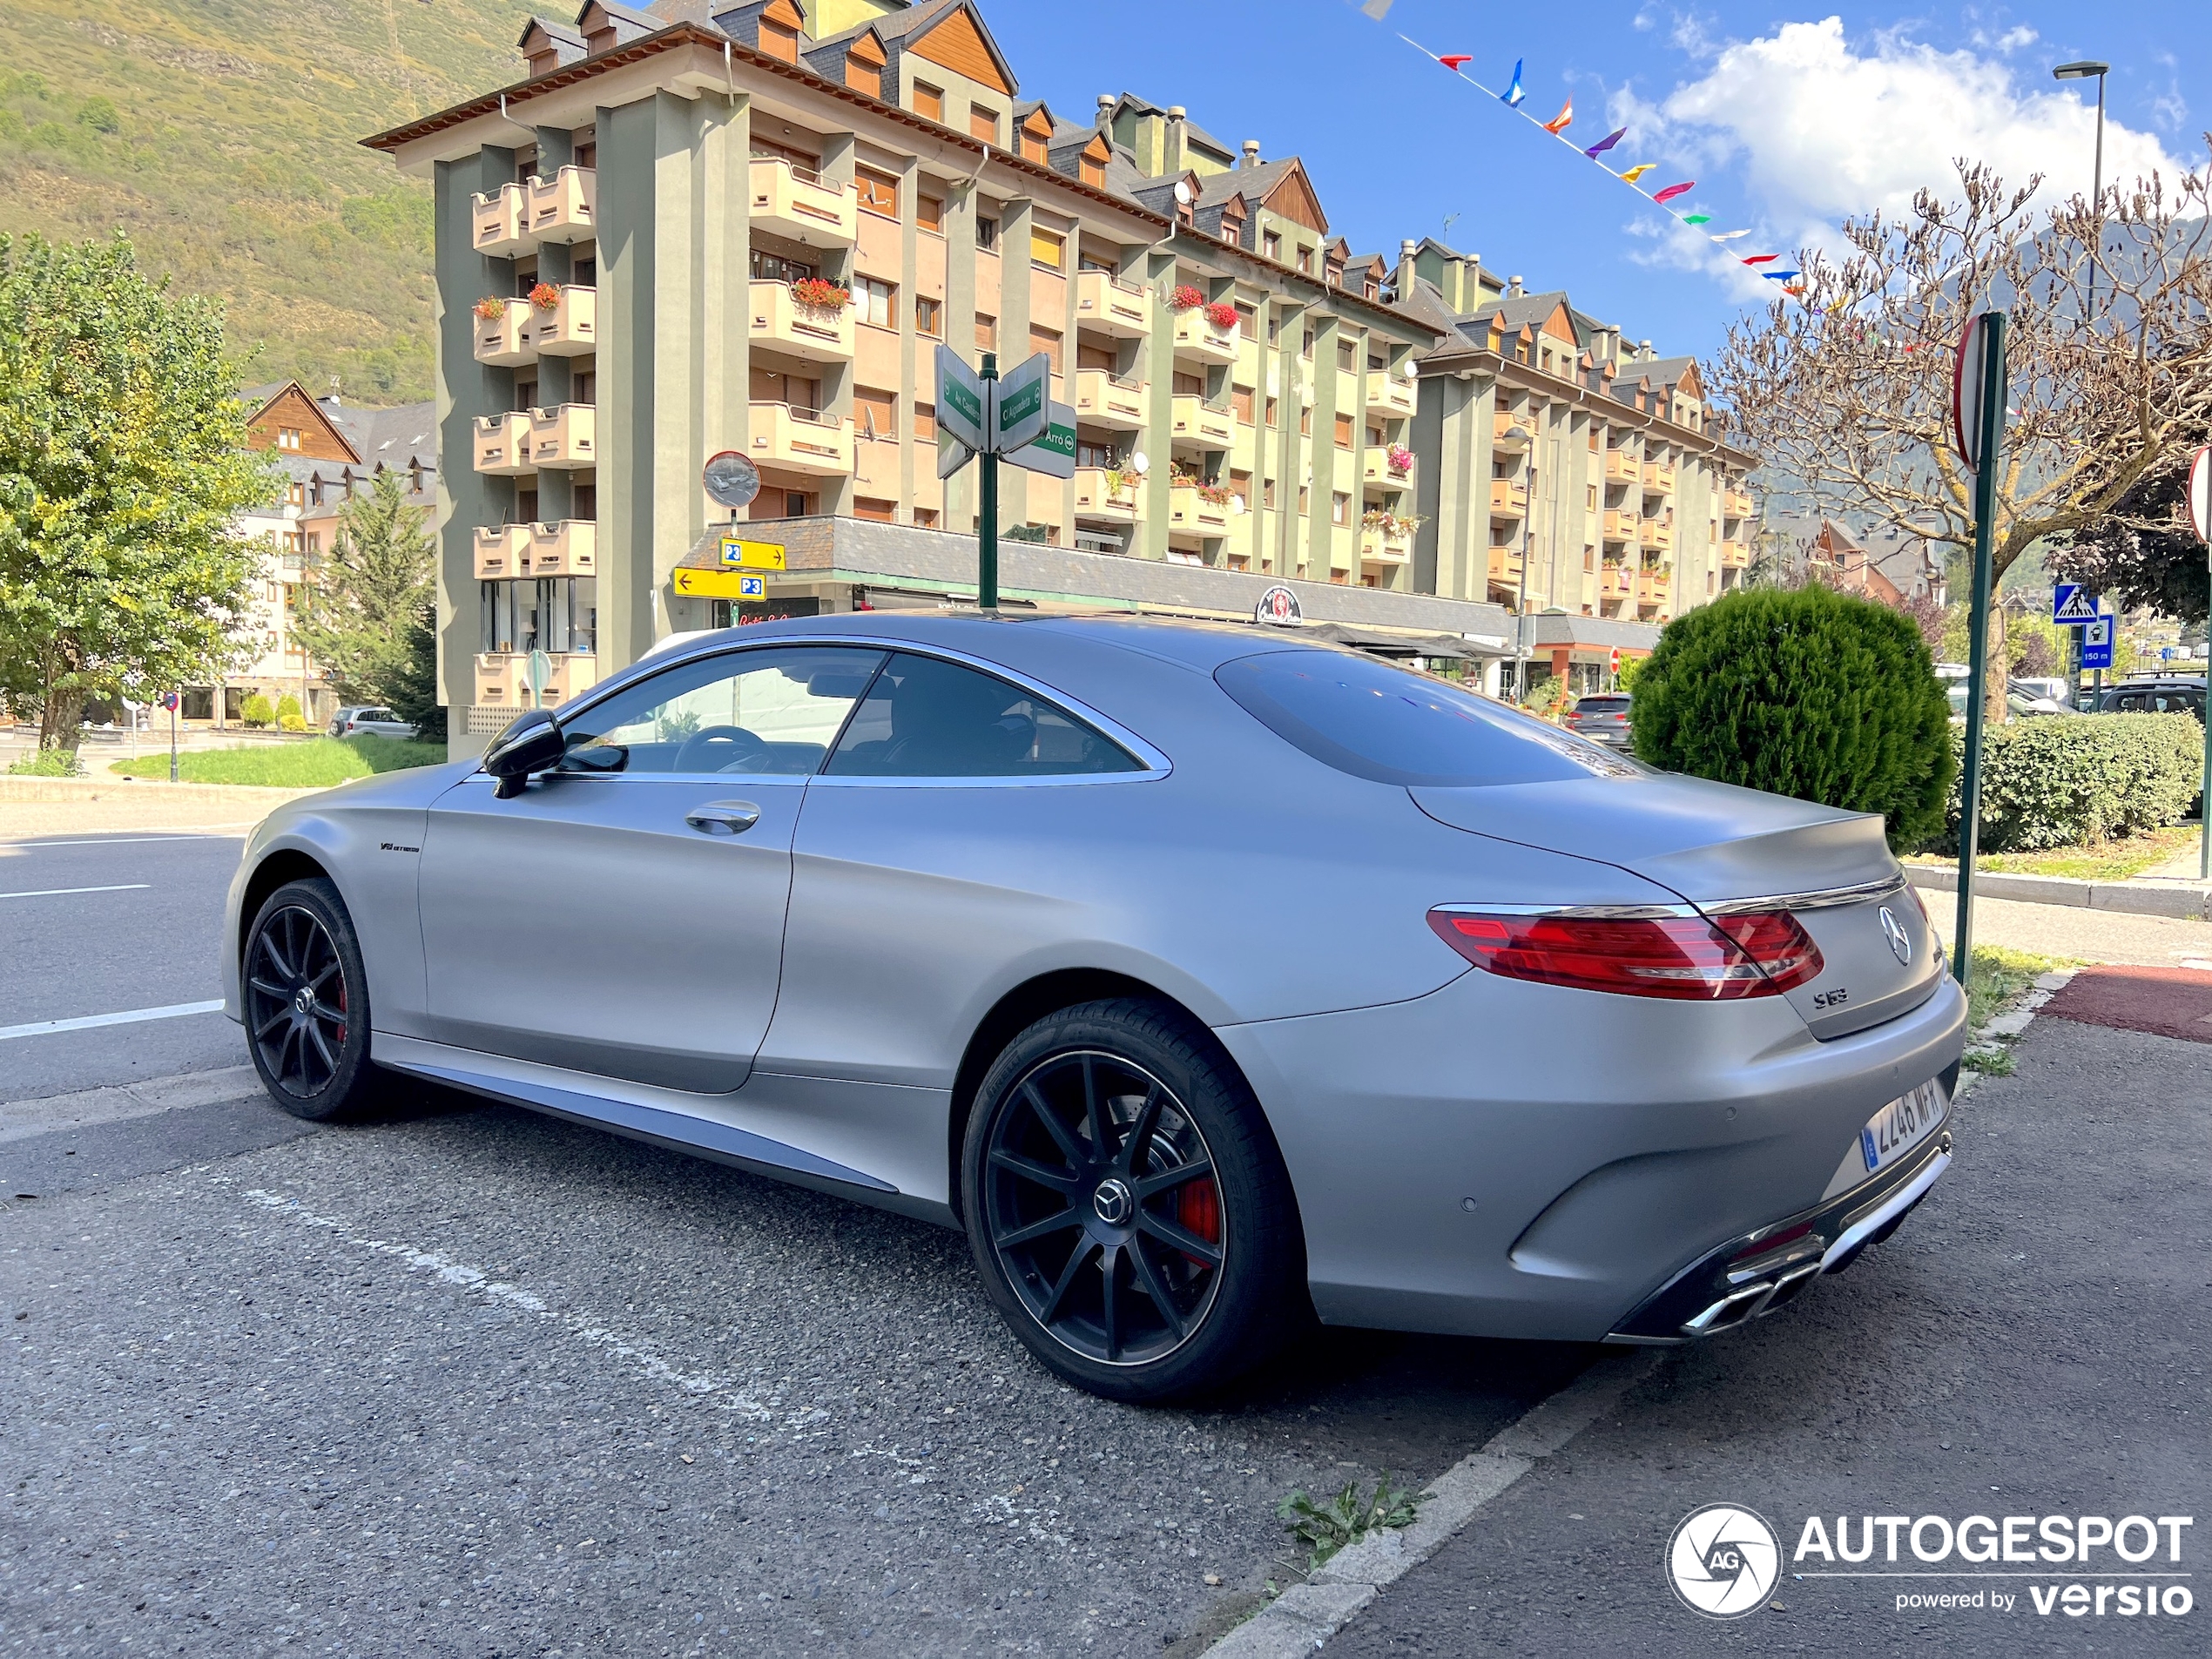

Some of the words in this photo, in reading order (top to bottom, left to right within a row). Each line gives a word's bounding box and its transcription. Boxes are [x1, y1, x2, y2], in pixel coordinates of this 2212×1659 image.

[1045, 429, 1064, 445] Arró
[2085, 652, 2099, 661] 150
[1813, 988, 1849, 1009] S63
[1879, 1094, 1916, 1155] 2246
